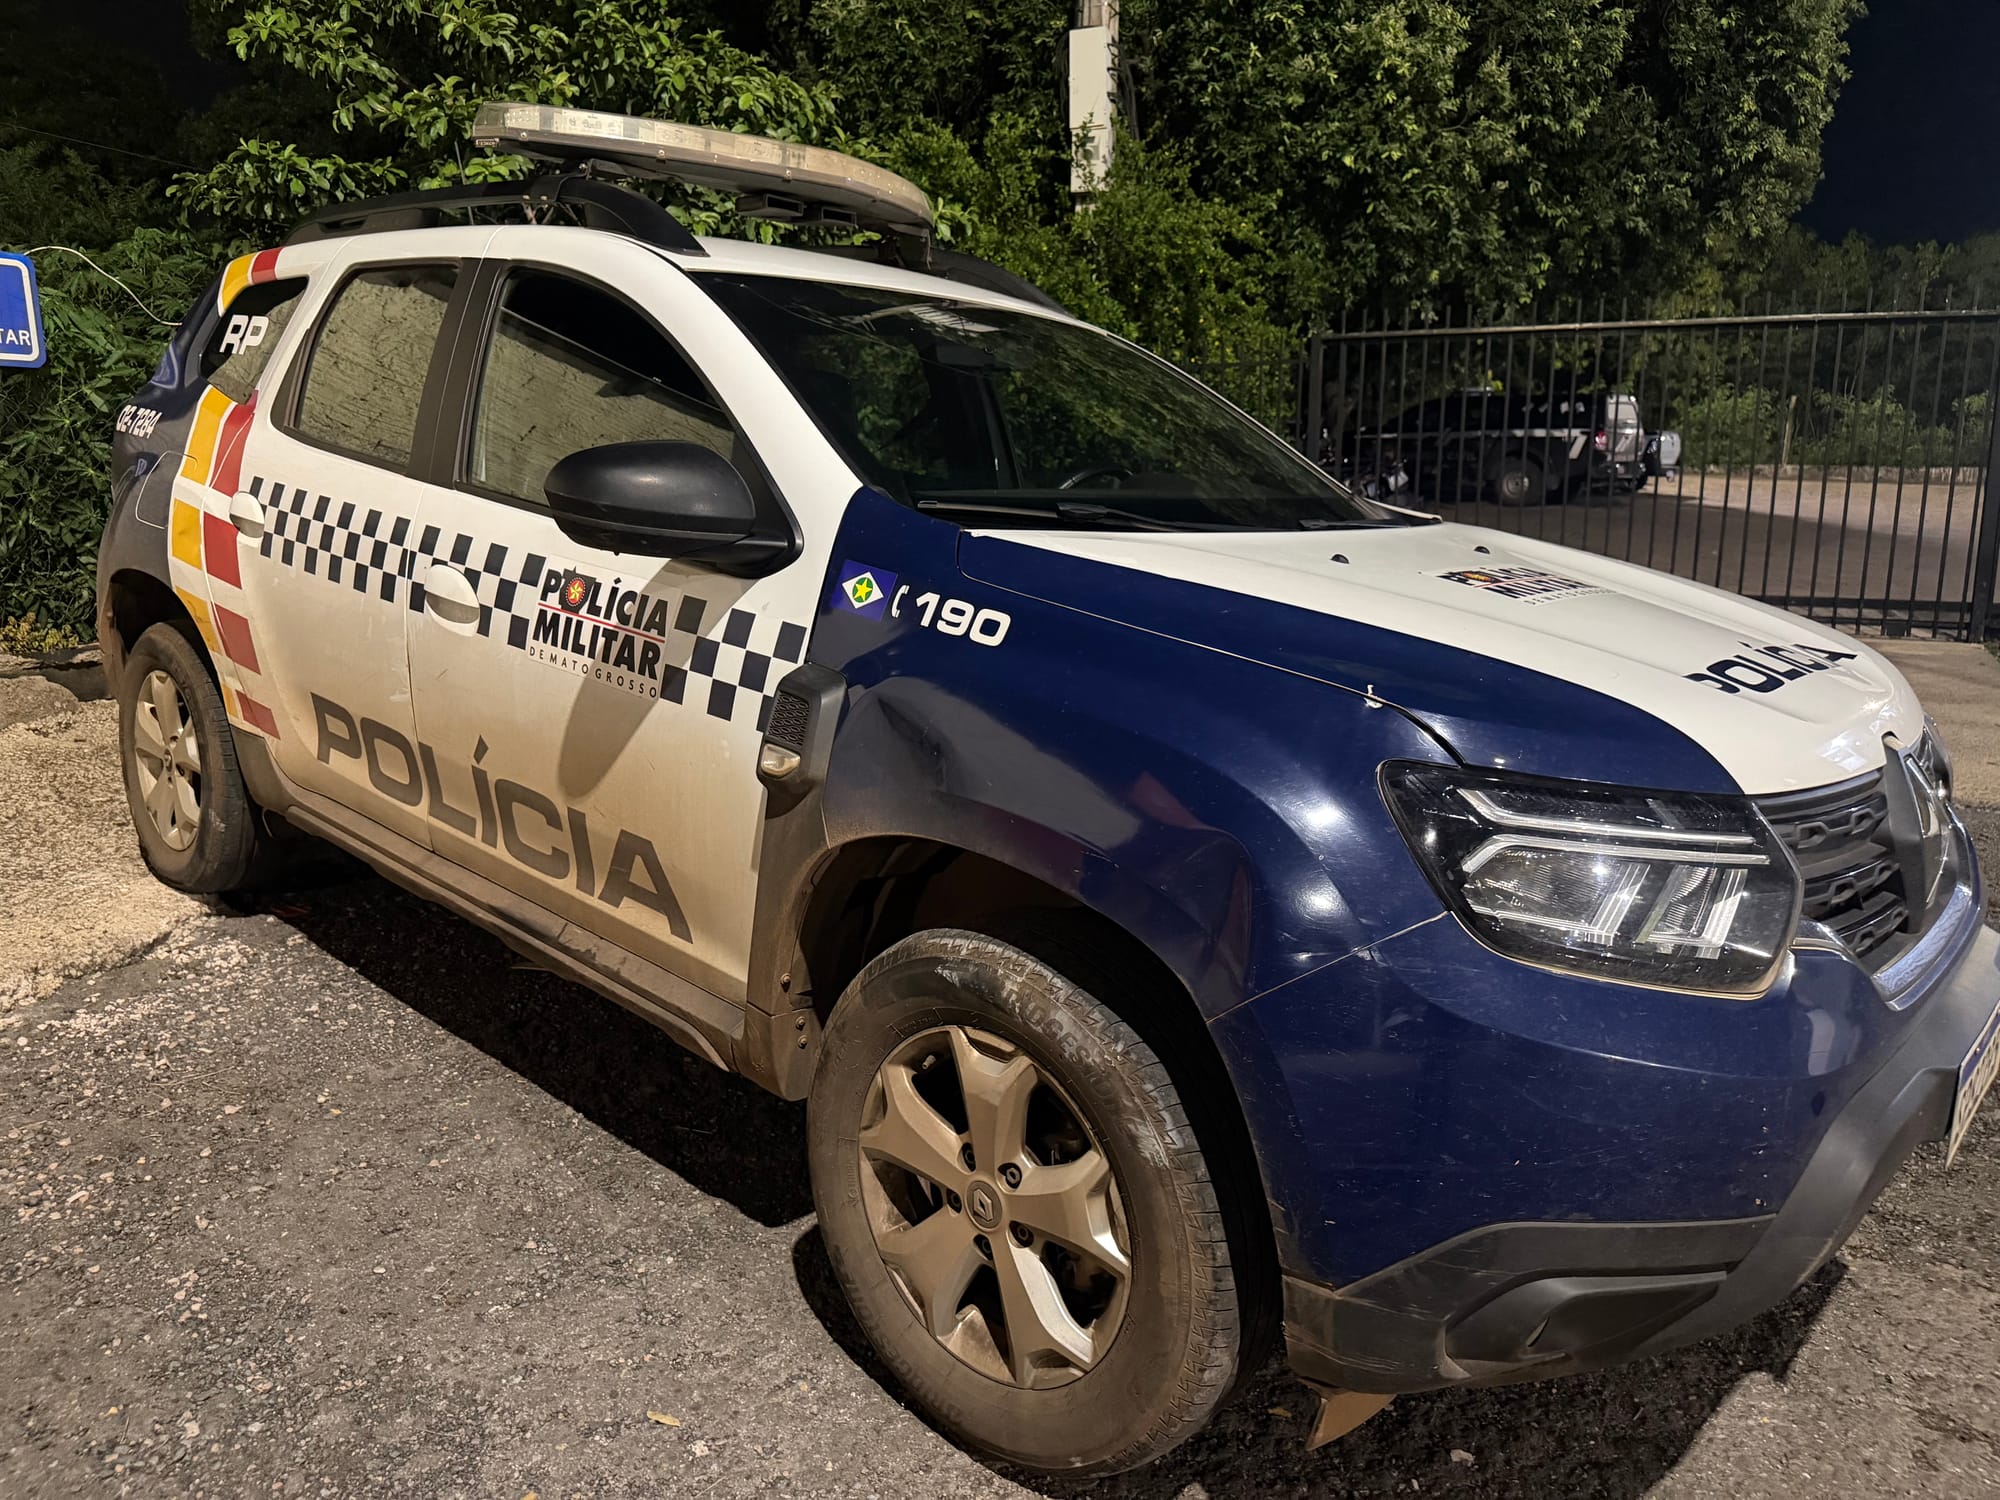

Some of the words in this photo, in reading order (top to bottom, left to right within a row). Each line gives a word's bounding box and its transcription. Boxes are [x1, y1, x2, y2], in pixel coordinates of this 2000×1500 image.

[219, 314, 269, 355] RP
[532, 609, 661, 681] MILITAR
[916, 591, 1011, 647] 190
[529, 646, 544, 660] DE
[549, 652, 589, 675] MATO
[595, 668, 657, 698] GROSSO
[311, 691, 694, 945] POLÍCIA
